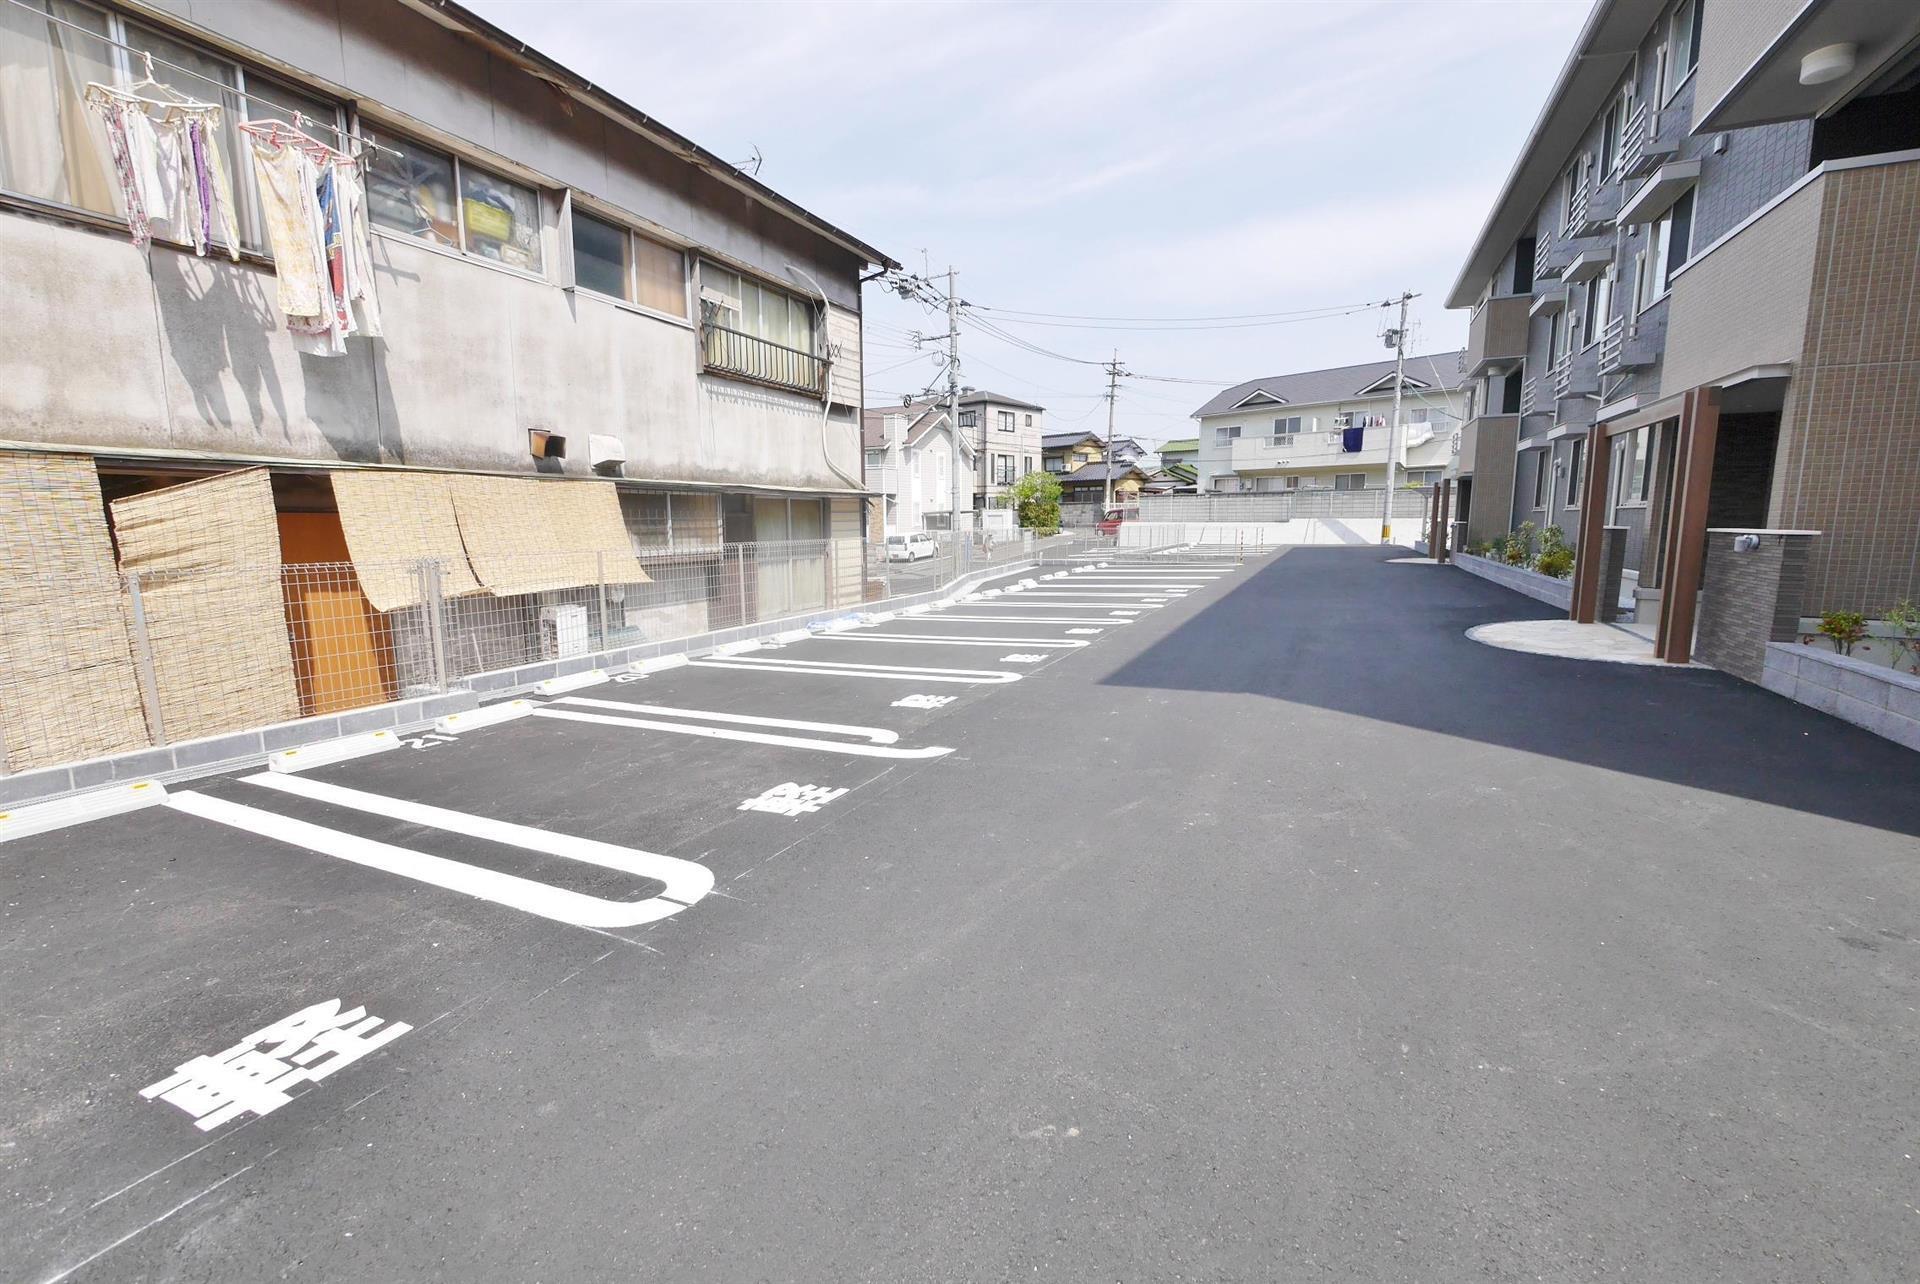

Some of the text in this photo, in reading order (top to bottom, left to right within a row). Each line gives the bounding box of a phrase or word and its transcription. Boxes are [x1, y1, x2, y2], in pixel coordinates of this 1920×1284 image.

[400, 734, 460, 749] 21
[736, 781, 850, 817] 軽
[138, 997, 414, 1132] 軽
